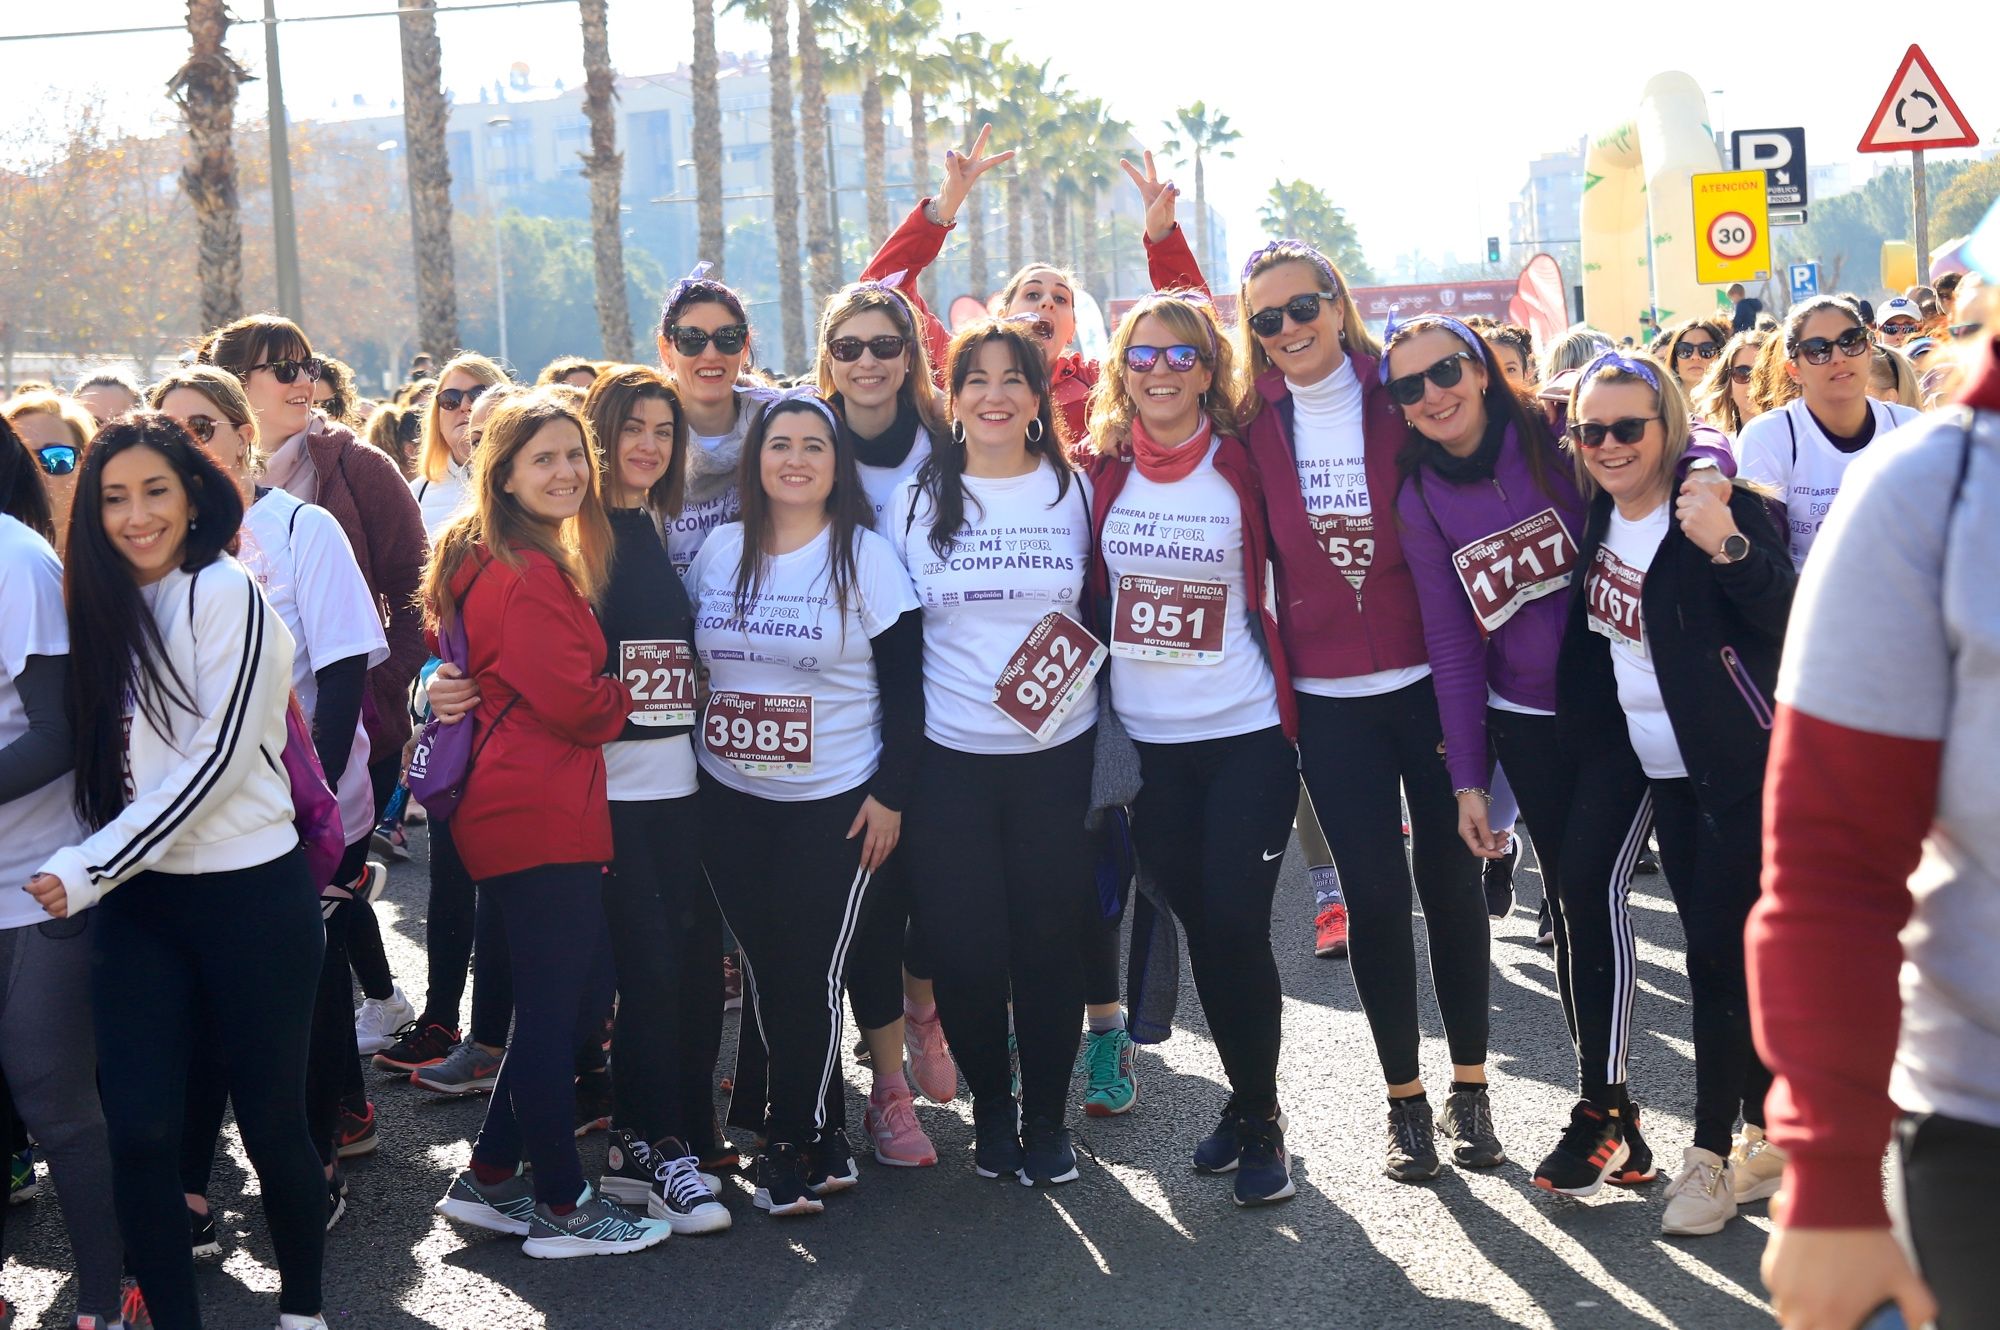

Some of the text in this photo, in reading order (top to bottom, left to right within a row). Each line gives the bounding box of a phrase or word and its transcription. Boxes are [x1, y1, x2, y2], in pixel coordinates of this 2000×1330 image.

[1739, 133, 1792, 170] P
[1701, 181, 1758, 193] ATENCIÓN
[1719, 228, 1745, 244] 30
[1793, 267, 1811, 288] P
[1296, 457, 1365, 468] RERA DE LA MUJ
[1310, 469, 1331, 488] MÍ
[1334, 474, 1345, 487] Y
[1347, 473, 1366, 486] PO
[1303, 489, 1368, 510] MPAÑE
[1793, 486, 1810, 495] VIII
[675, 514, 729, 532] COMPA
[1111, 506, 1230, 525] CARRERA DE LA MUJER 2023
[1346, 517, 1373, 527] MURC
[990, 528, 1002, 536] DE
[1005, 527, 1016, 535] LA
[1051, 527, 1071, 535] 2023
[1106, 521, 1204, 541] POR MÍ Y POR
[1510, 515, 1552, 538] MURCIA
[980, 536, 1002, 551] MÍ
[1005, 540, 1017, 551] Y
[1020, 540, 1051, 550] POR
[1108, 540, 1225, 563] COMPAÑERAS
[1318, 537, 1375, 567] 53
[1474, 539, 1505, 560] mujer
[922, 552, 1073, 575] MIS COMPAÑERAS
[1472, 532, 1565, 603] 1717
[777, 594, 804, 602] MUJER
[807, 596, 828, 605] 2023
[1139, 584, 1224, 600] mujer MURCIA
[1589, 574, 1638, 627] 1767
[707, 601, 733, 613] POR
[760, 606, 771, 617] Y
[770, 607, 800, 619] POR
[704, 616, 823, 640] COMPAÑERAS
[1130, 601, 1205, 639] 951
[1143, 638, 1190, 648] MOTOMAMIS
[643, 649, 670, 665] mujer
[1003, 653, 1028, 685] mujer
[1016, 635, 1082, 711] 952
[626, 668, 696, 700] 2271
[1050, 667, 1081, 707] MOTOMAMIS
[725, 698, 807, 714] mujer MURCIA
[707, 715, 808, 753] 3985
[740, 753, 786, 761] MOTOMAMIS
[567, 1213, 590, 1229] FILA
